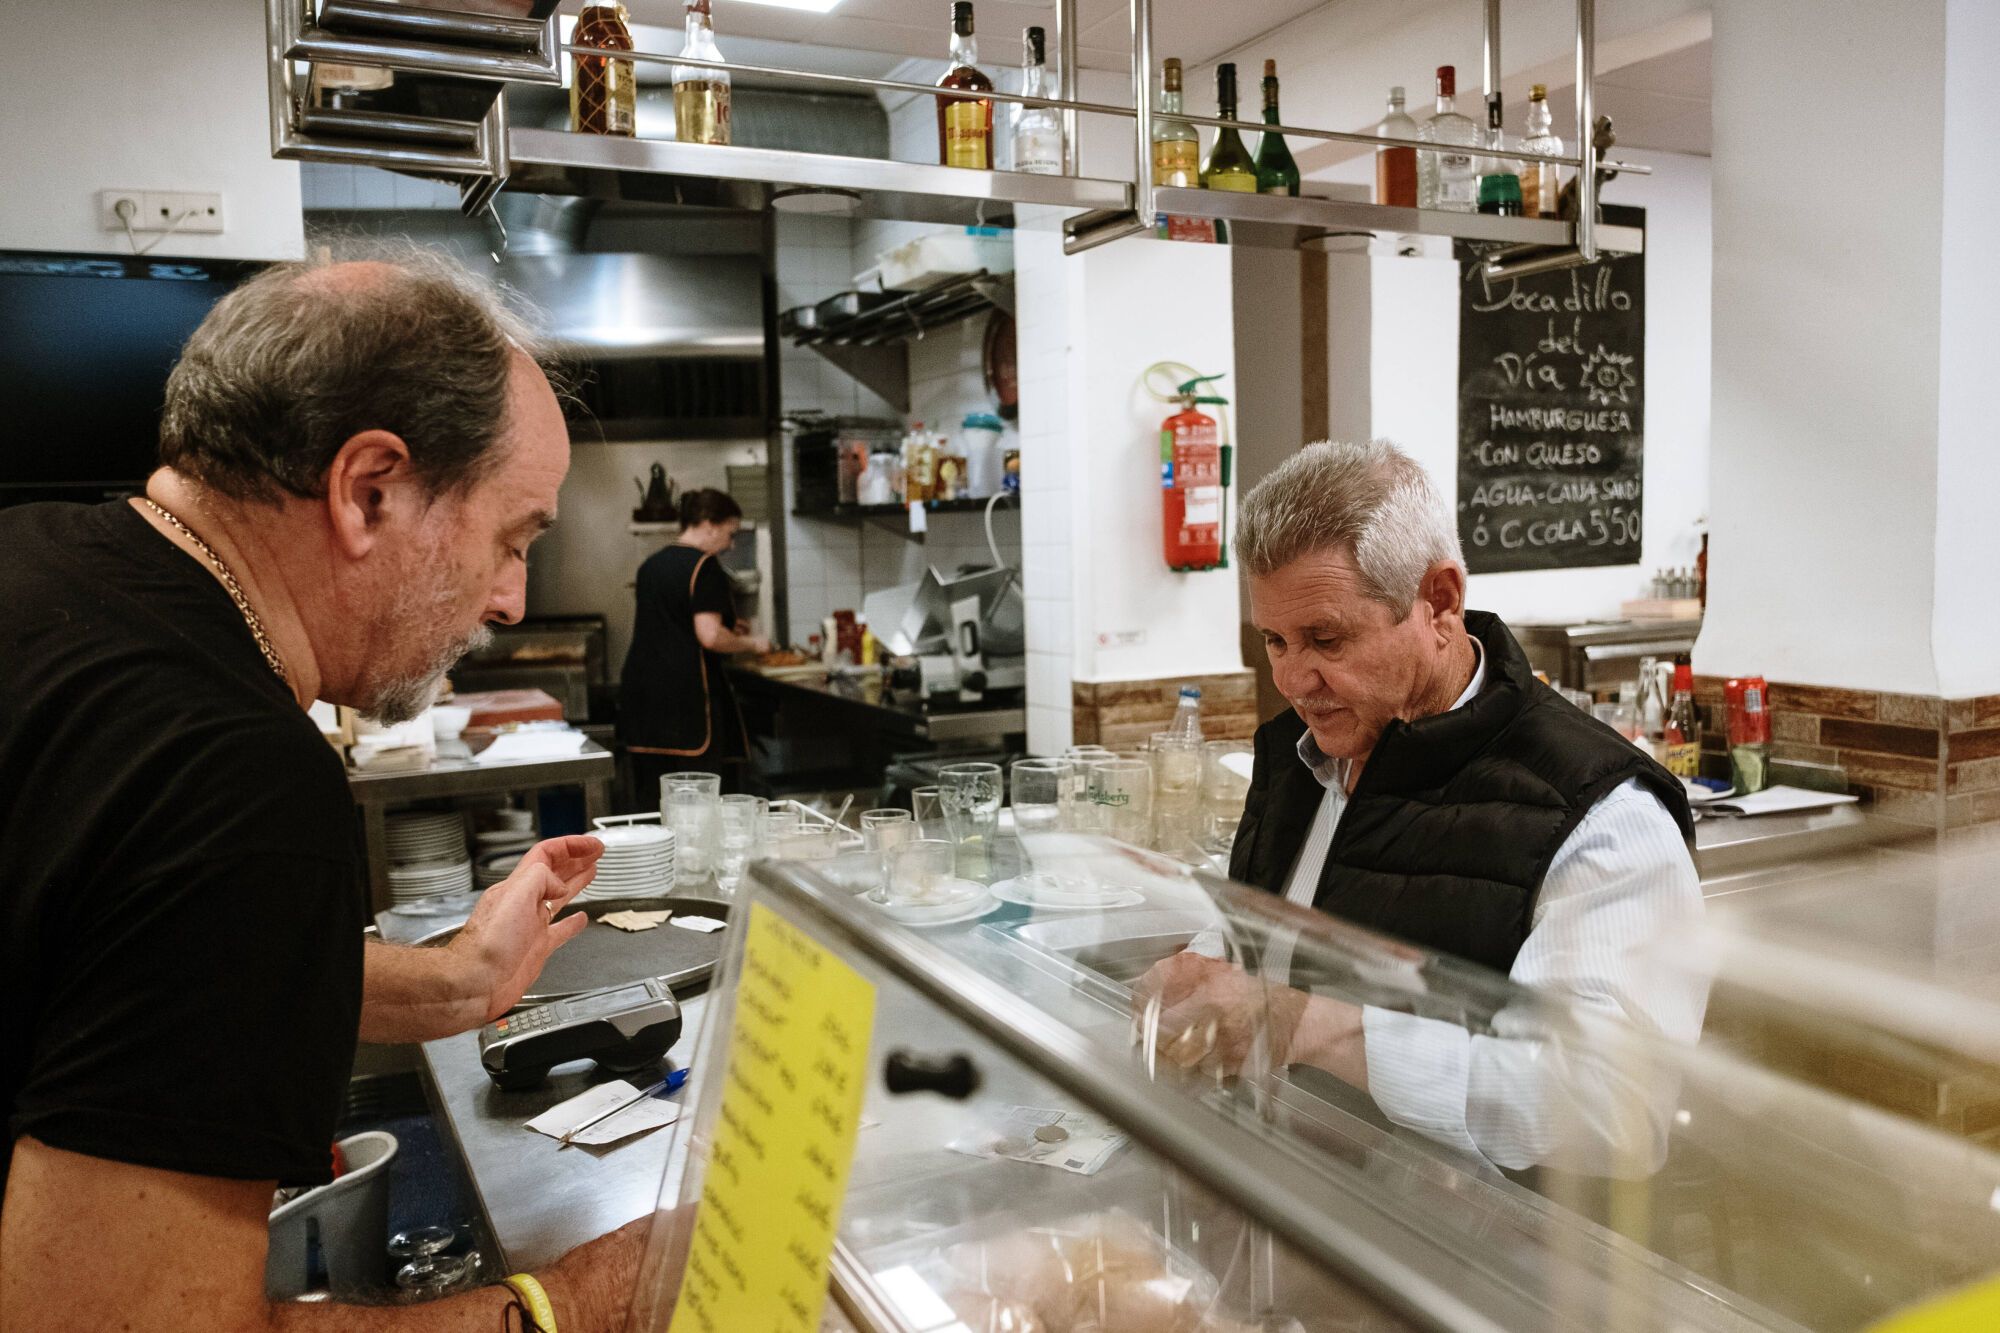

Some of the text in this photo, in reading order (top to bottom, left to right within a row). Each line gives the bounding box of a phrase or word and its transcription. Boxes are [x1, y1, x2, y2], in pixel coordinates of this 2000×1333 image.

[1538, 315, 1585, 355] del
[1490, 404, 1633, 433] HAMBURGUESA
[1525, 441, 1602, 470] QUESO
